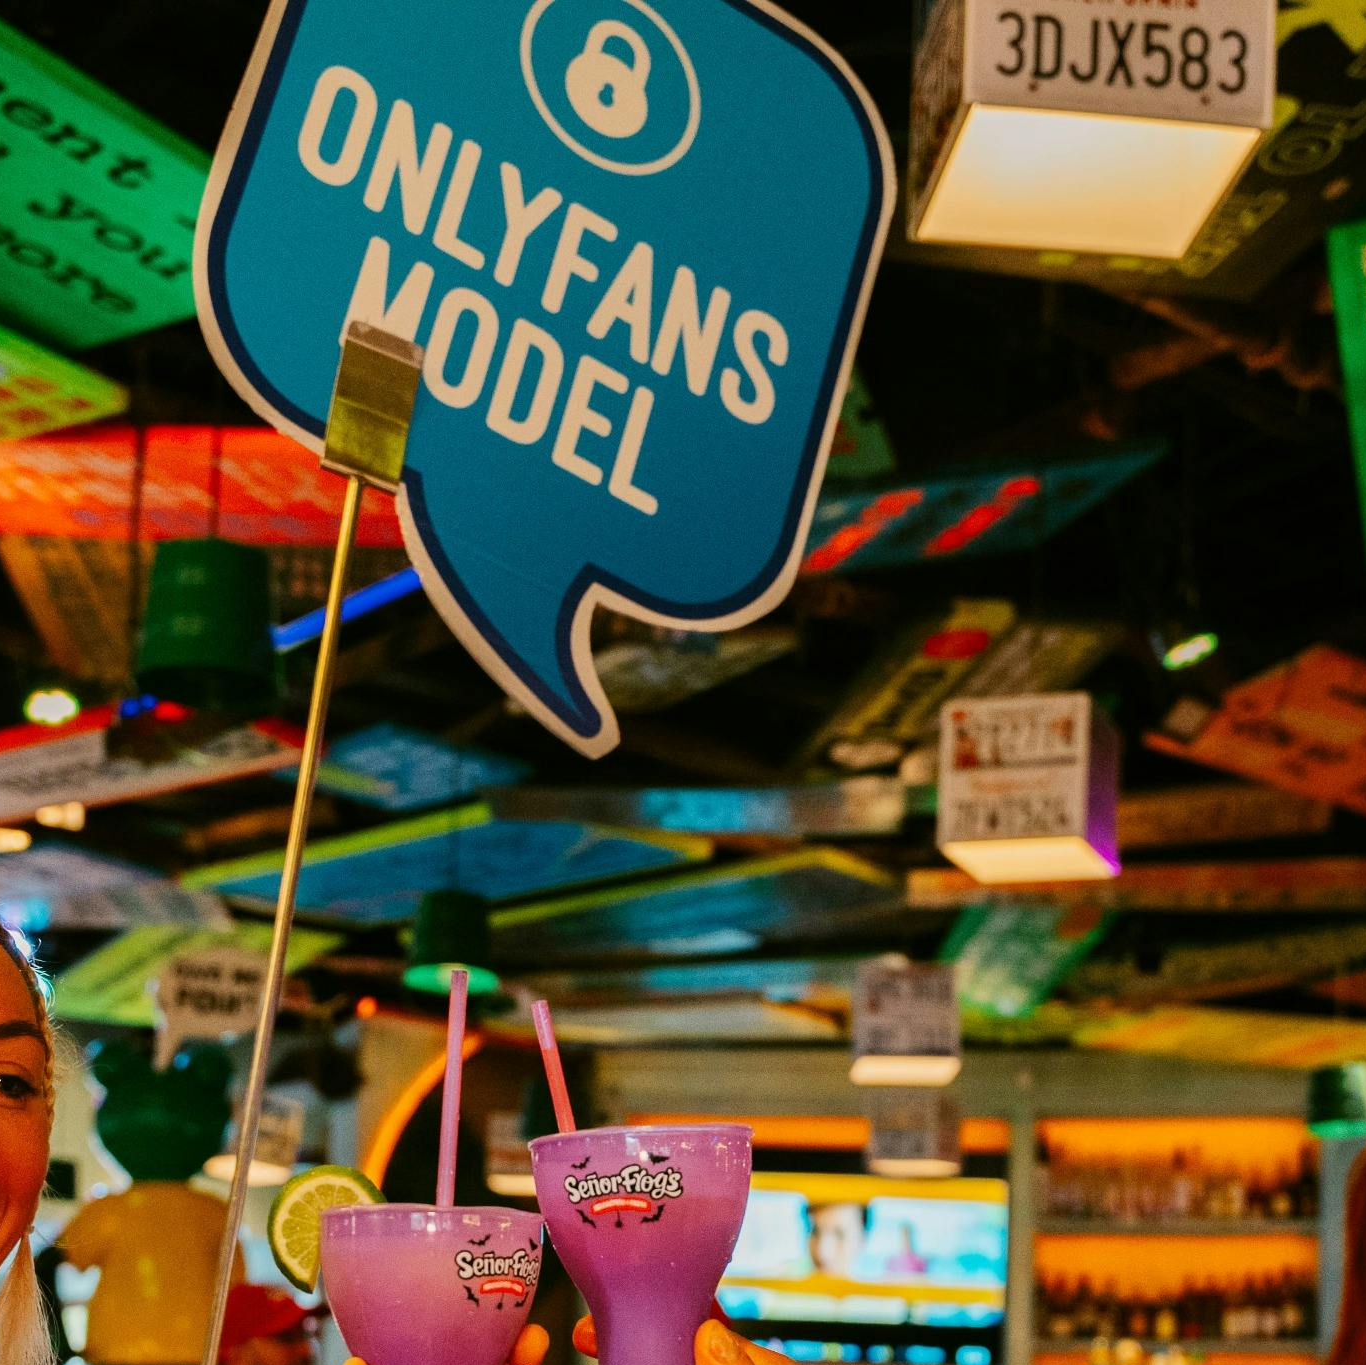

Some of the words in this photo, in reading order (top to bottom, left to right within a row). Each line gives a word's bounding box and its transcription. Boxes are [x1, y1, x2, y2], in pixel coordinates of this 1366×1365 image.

[996, 11, 1248, 95] 3DJX583
[27, 191, 192, 281] you
[297, 64, 790, 425] ONLYFANS
[341, 236, 659, 516] MODEL
[564, 1171, 623, 1204] Señor
[455, 1250, 514, 1280] Señor
